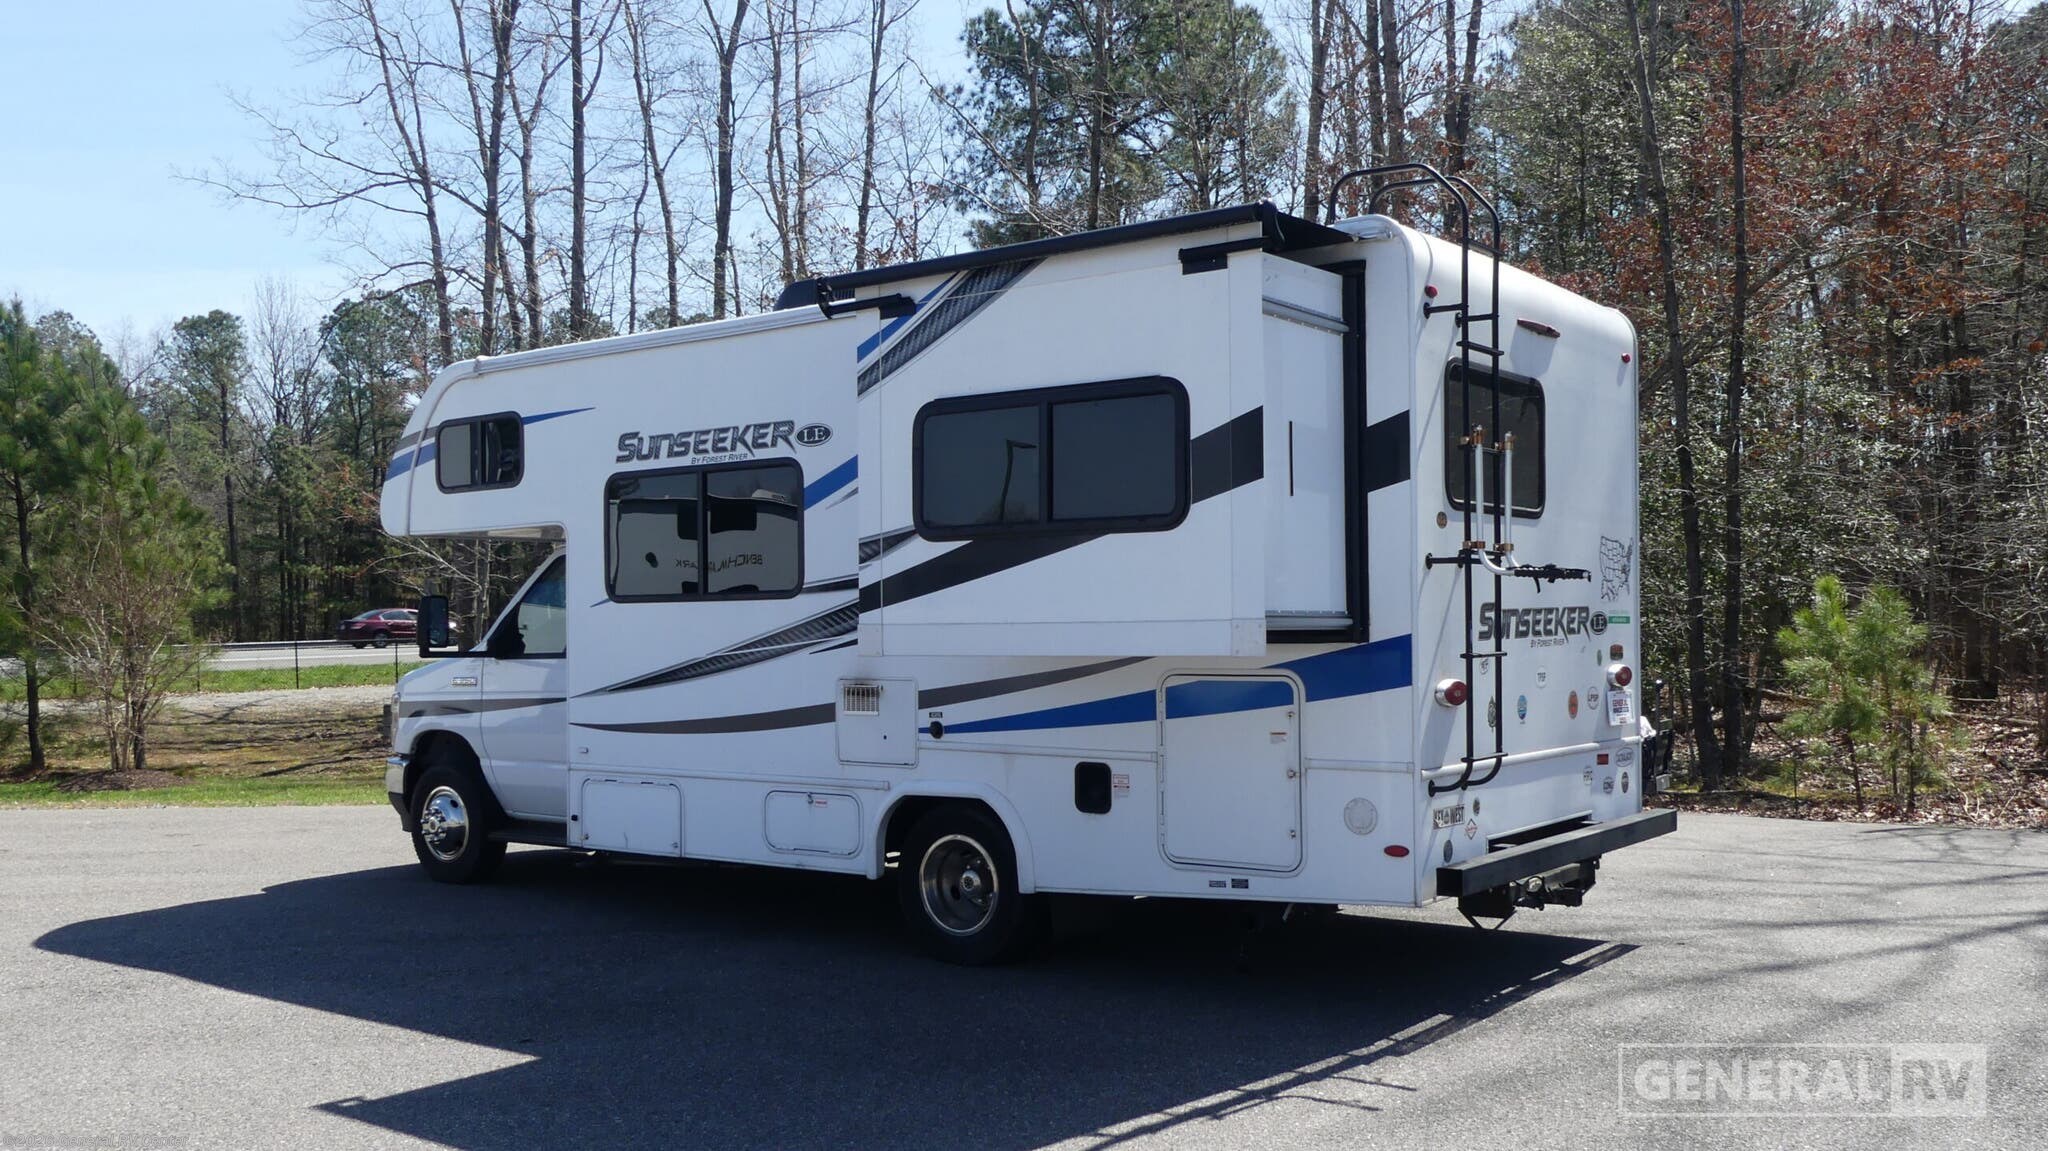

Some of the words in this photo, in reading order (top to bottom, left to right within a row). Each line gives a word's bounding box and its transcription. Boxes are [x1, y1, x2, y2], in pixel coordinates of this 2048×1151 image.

[802, 427, 826, 442] LE
[691, 456, 701, 465] BY
[701, 454, 728, 464] FOREST
[728, 452, 748, 462] RIVER
